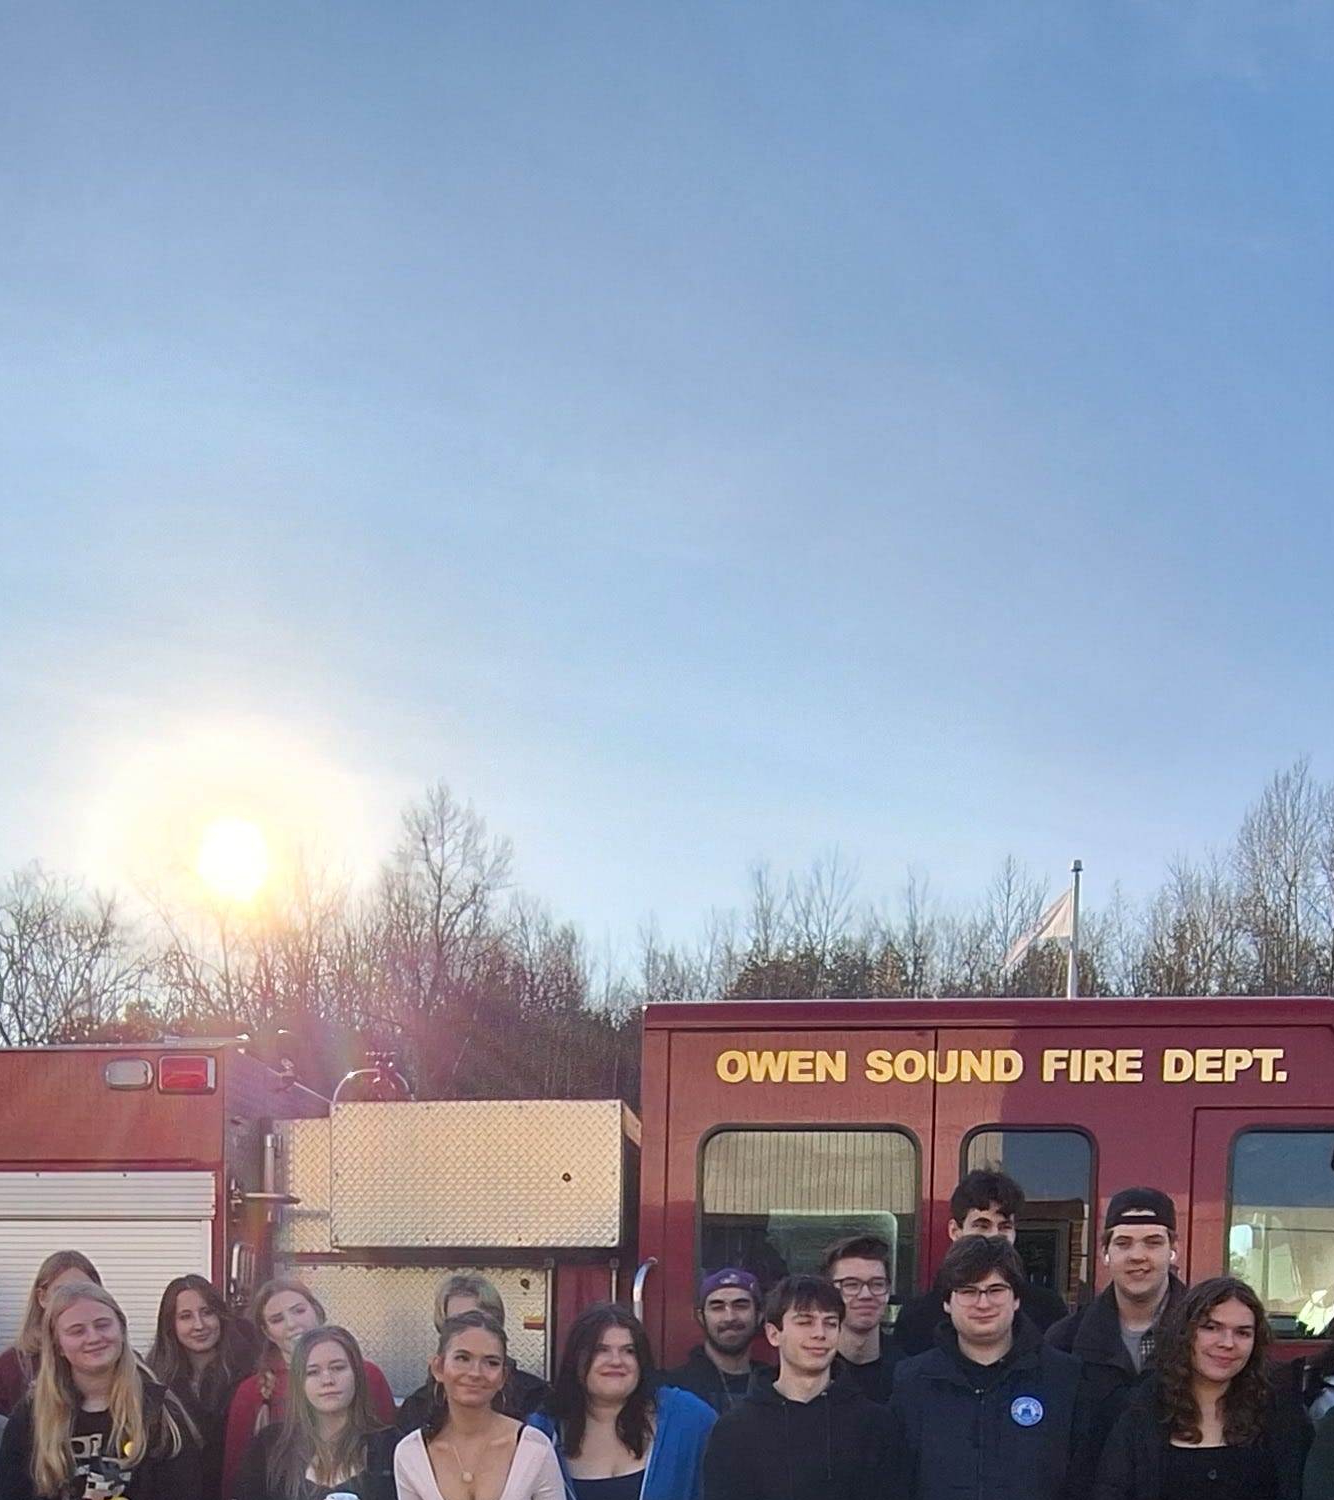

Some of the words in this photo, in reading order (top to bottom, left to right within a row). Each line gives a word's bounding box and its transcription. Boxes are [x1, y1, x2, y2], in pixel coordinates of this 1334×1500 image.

[716, 1050, 847, 1083] OWEN
[865, 1050, 1024, 1083] SOUND
[1042, 1049, 1144, 1083] FIRE
[1162, 1049, 1288, 1083] DEPT.
